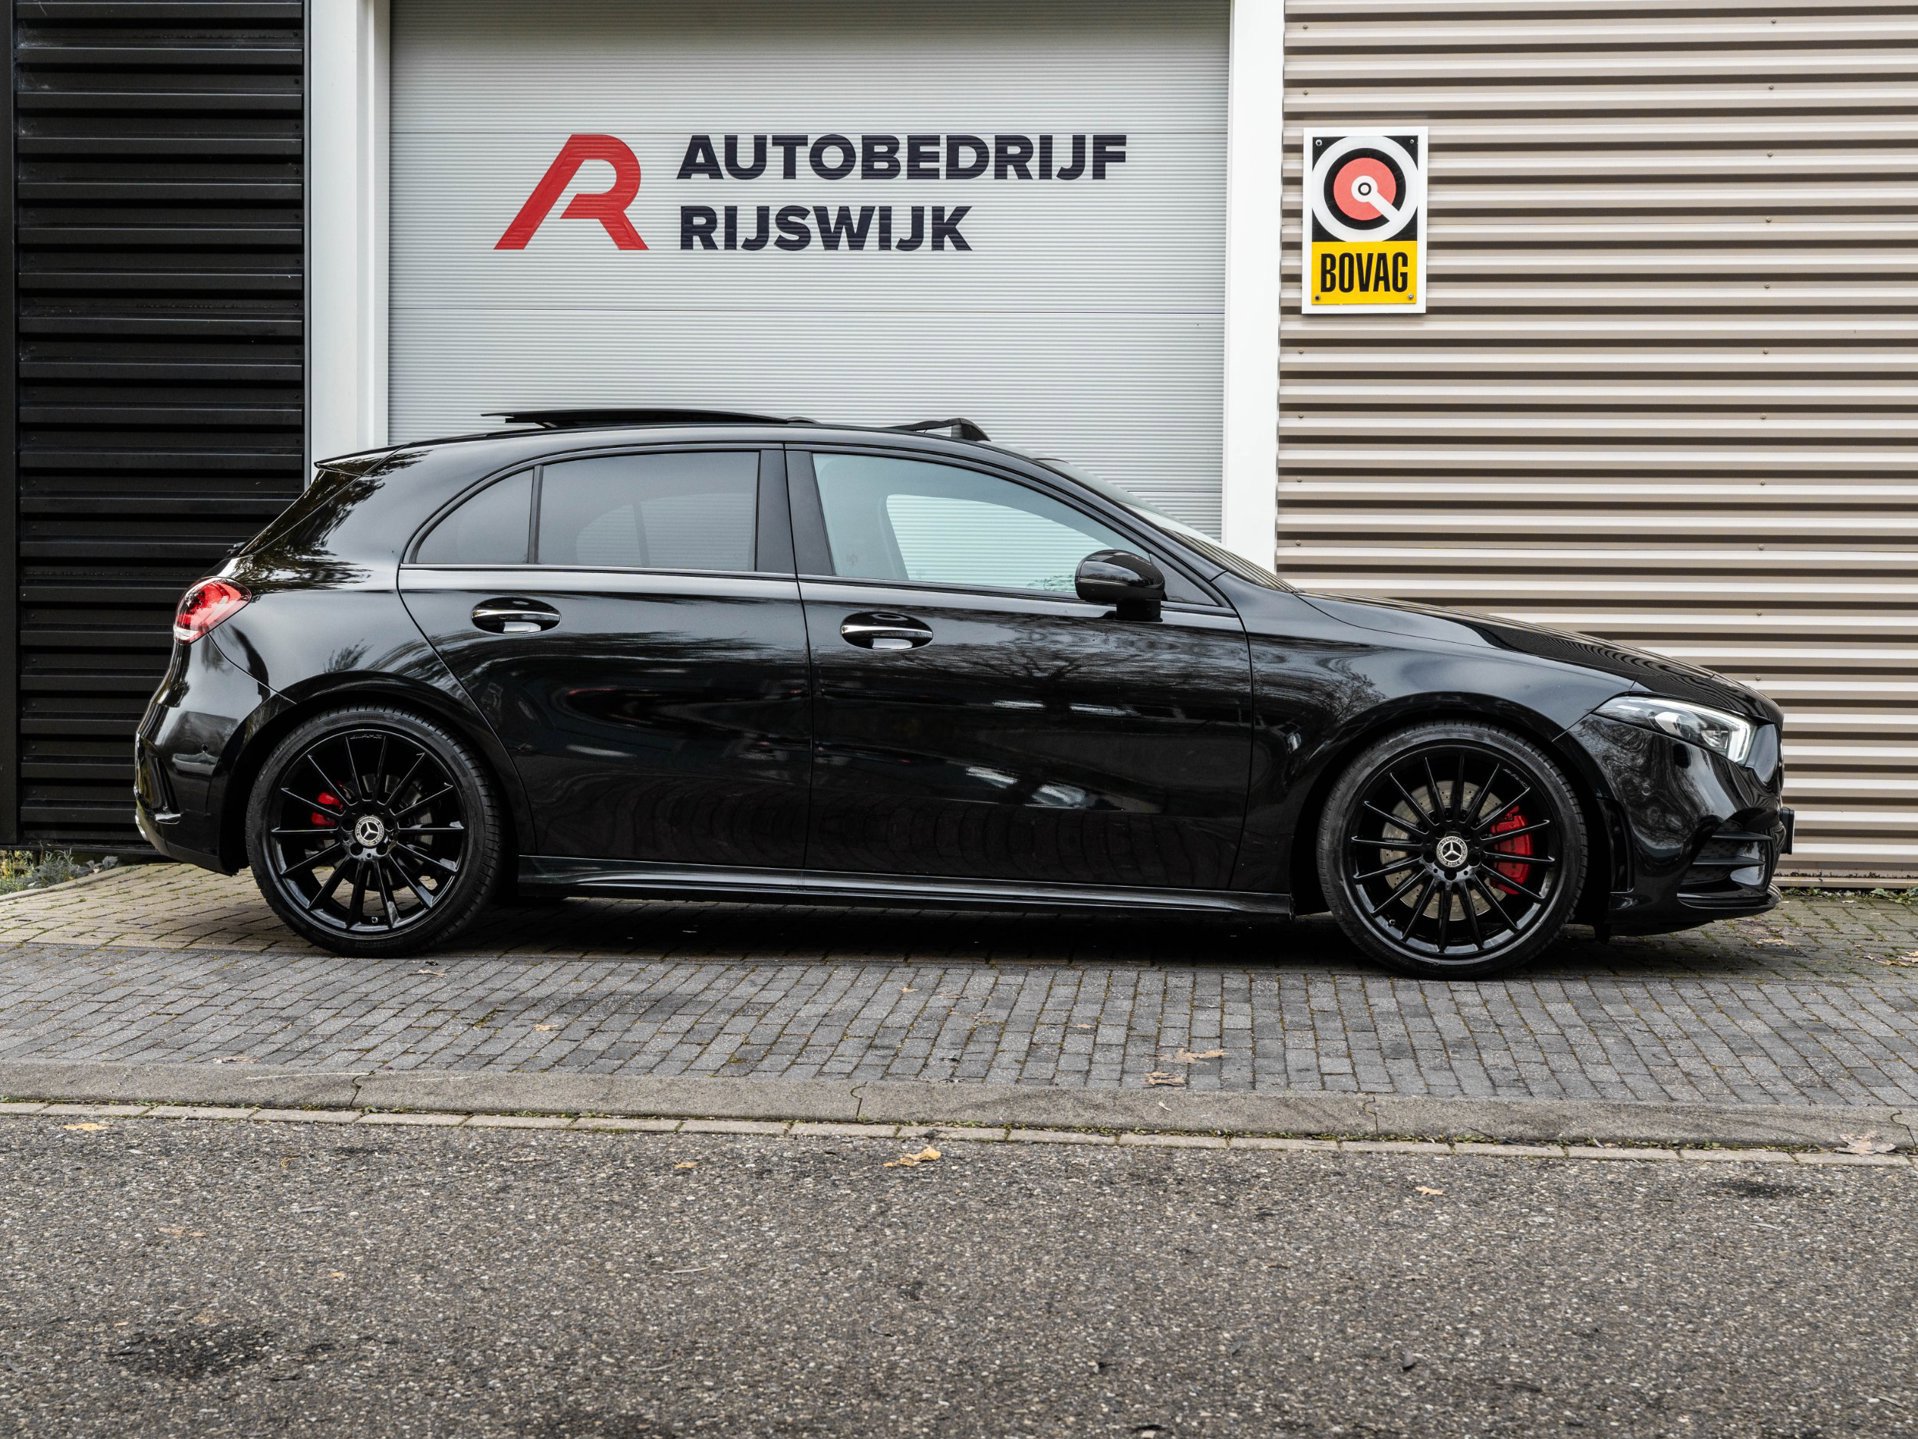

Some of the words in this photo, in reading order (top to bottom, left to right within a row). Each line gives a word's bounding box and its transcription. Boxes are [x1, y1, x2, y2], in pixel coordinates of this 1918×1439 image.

[676, 134, 1127, 180] AUTOBEDRIJF
[680, 205, 973, 251] RIJSWIJK
[1320, 252, 1408, 293] BOVAG
